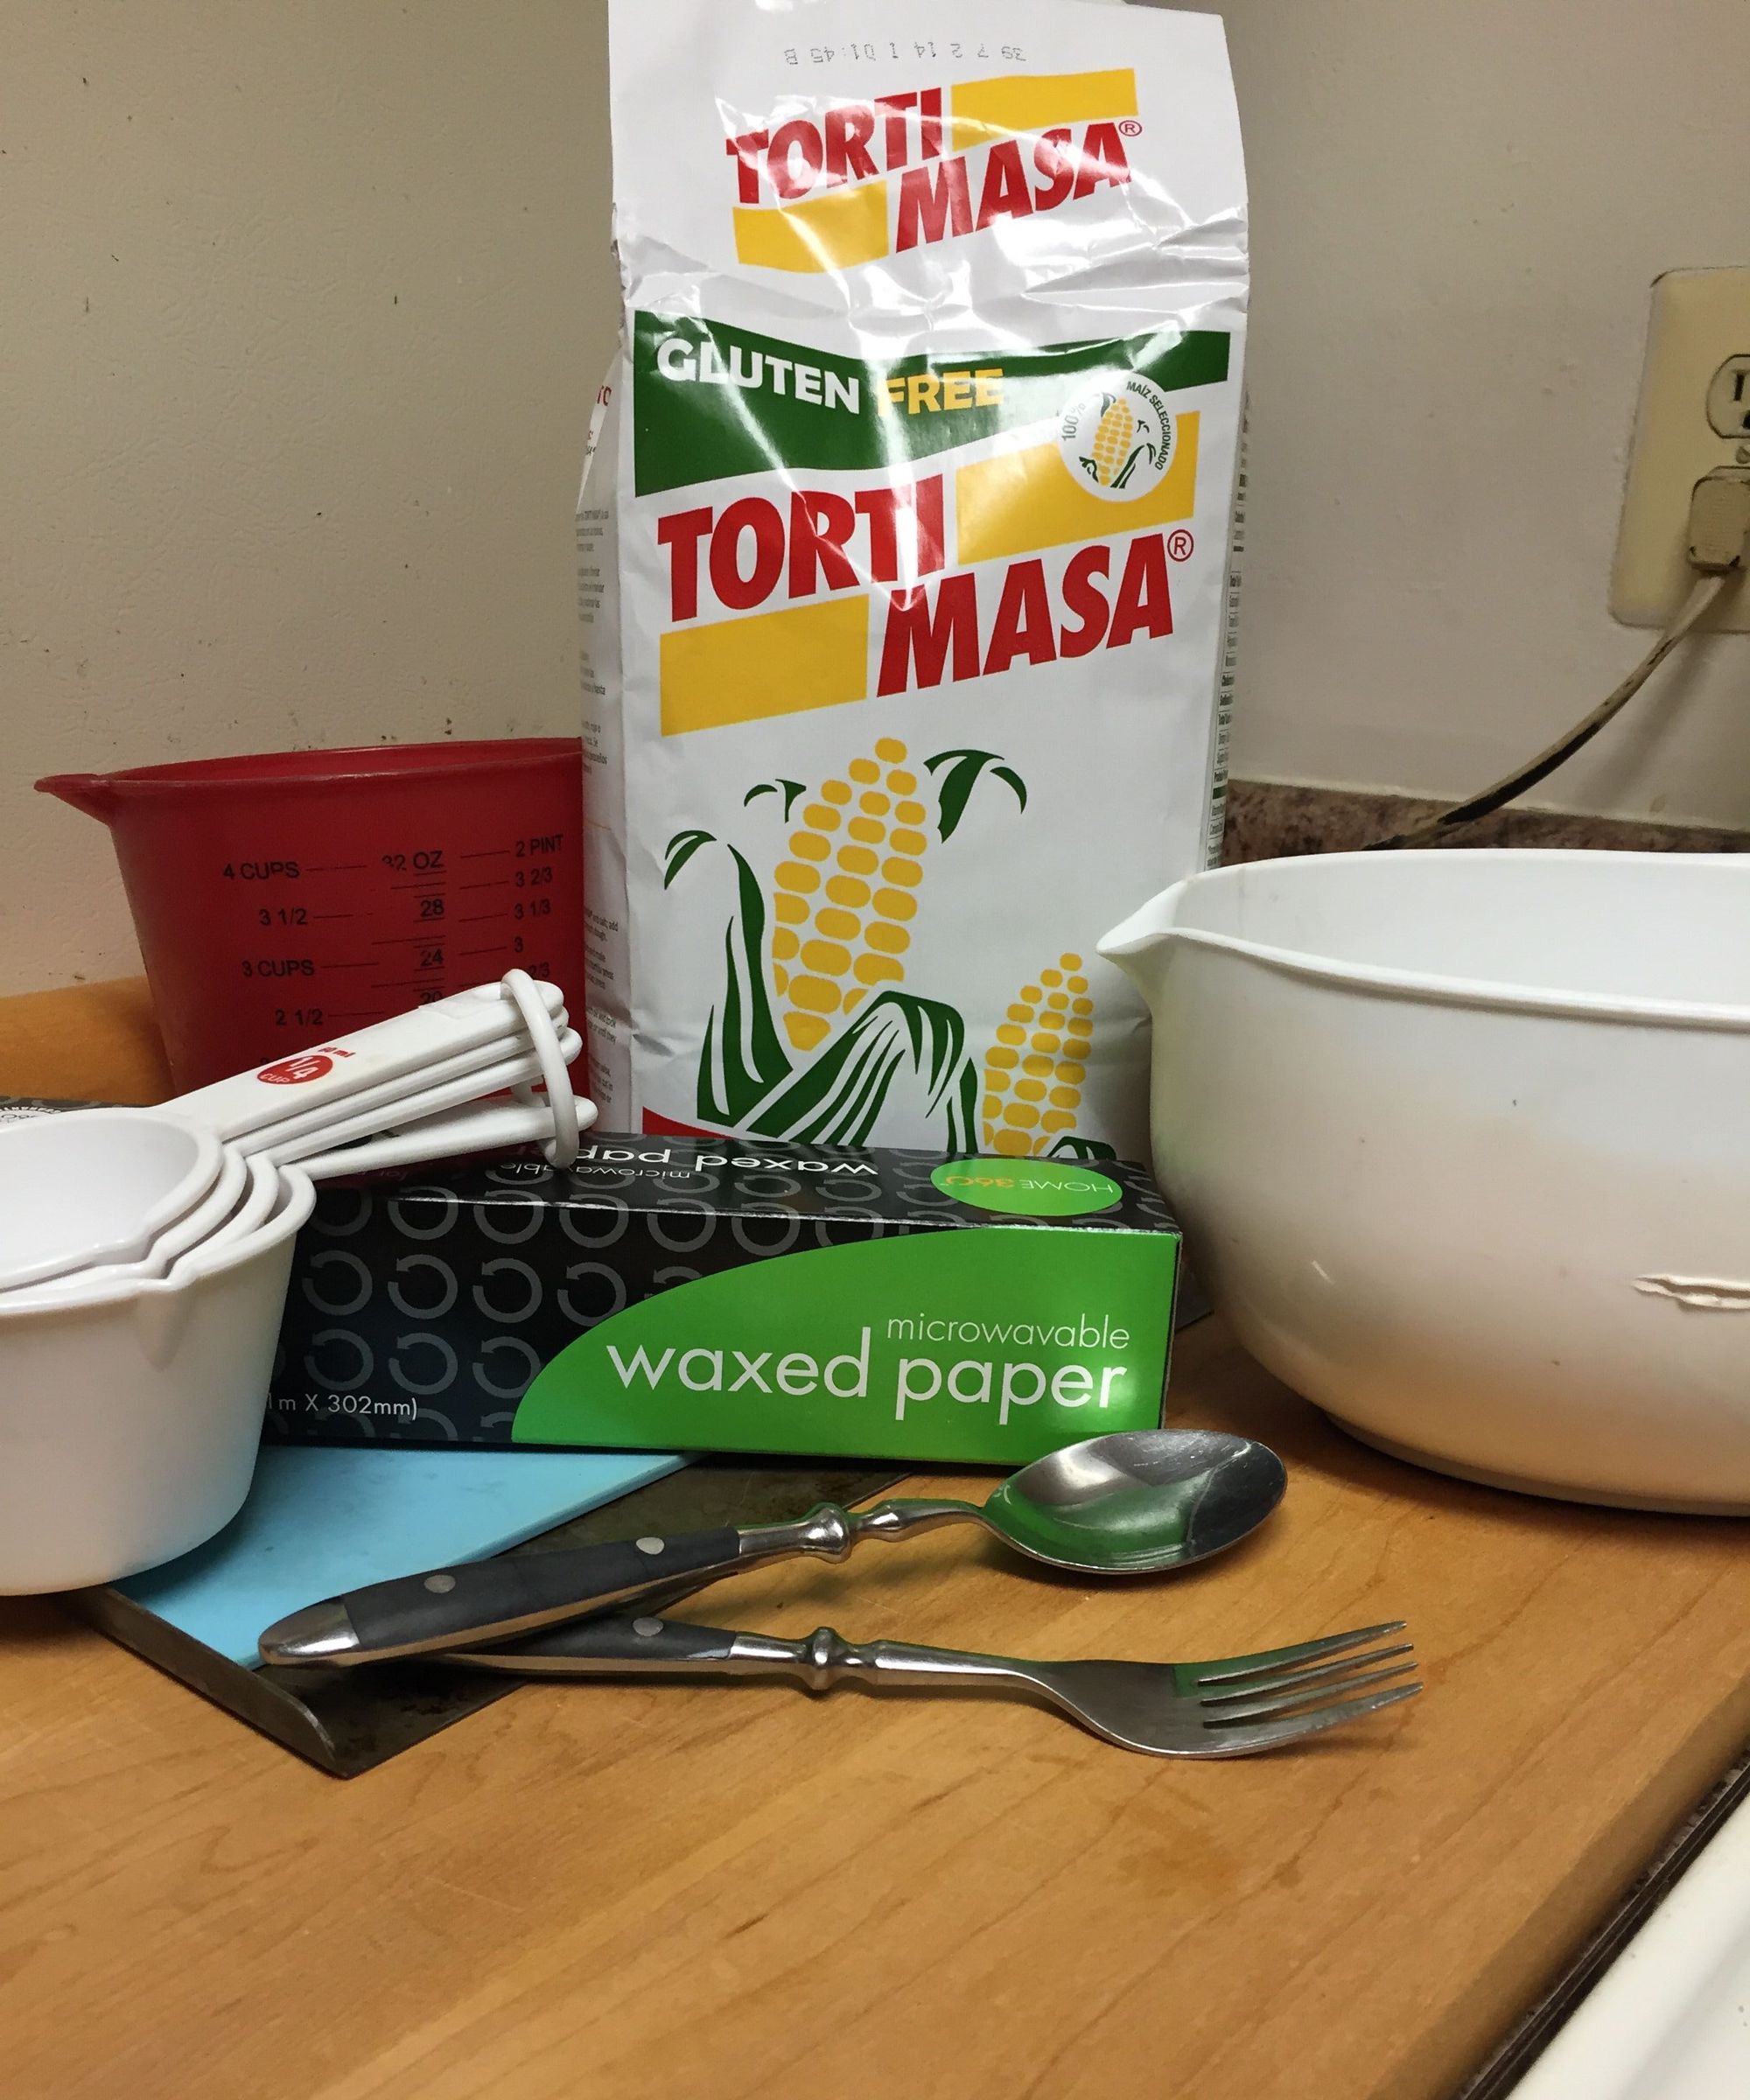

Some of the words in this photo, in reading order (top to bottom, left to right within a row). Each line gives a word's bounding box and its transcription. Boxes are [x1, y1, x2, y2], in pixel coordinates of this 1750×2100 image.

[950, 43, 963, 58] 2
[726, 87, 942, 205] TORTI
[657, 338, 860, 415] GLUTEN
[878, 368, 1005, 416] FREE
[1149, 395, 1172, 471] SELECCIONADO
[657, 473, 945, 623] TORTI
[515, 840, 526, 858] 2
[529, 834, 564, 856] PINT
[412, 850, 444, 870] OZ
[224, 864, 235, 880] 4
[240, 861, 301, 880] CUPS
[515, 872, 525, 889] 3
[530, 866, 554, 886] 2/3
[259, 908, 272, 927] 3
[277, 907, 308, 926] 1/2
[420, 899, 444, 918] 28
[514, 904, 525, 920] 3
[529, 899, 552, 917] 1/3
[514, 936, 524, 953] 3
[242, 960, 253, 977] 3
[257, 959, 315, 977] CUPS
[420, 948, 444, 968] 24
[275, 1009, 287, 1026] 2
[294, 1009, 324, 1026] 1/2
[259, 1073, 290, 1083] CUP
[695, 1153, 878, 1176] waxed
[1021, 1179, 1114, 1194] HOME
[888, 1312, 1130, 1350] microwavable
[606, 1326, 872, 1398] waxed
[895, 1357, 1128, 1425] paper
[327, 1394, 417, 1421] 302mm)
